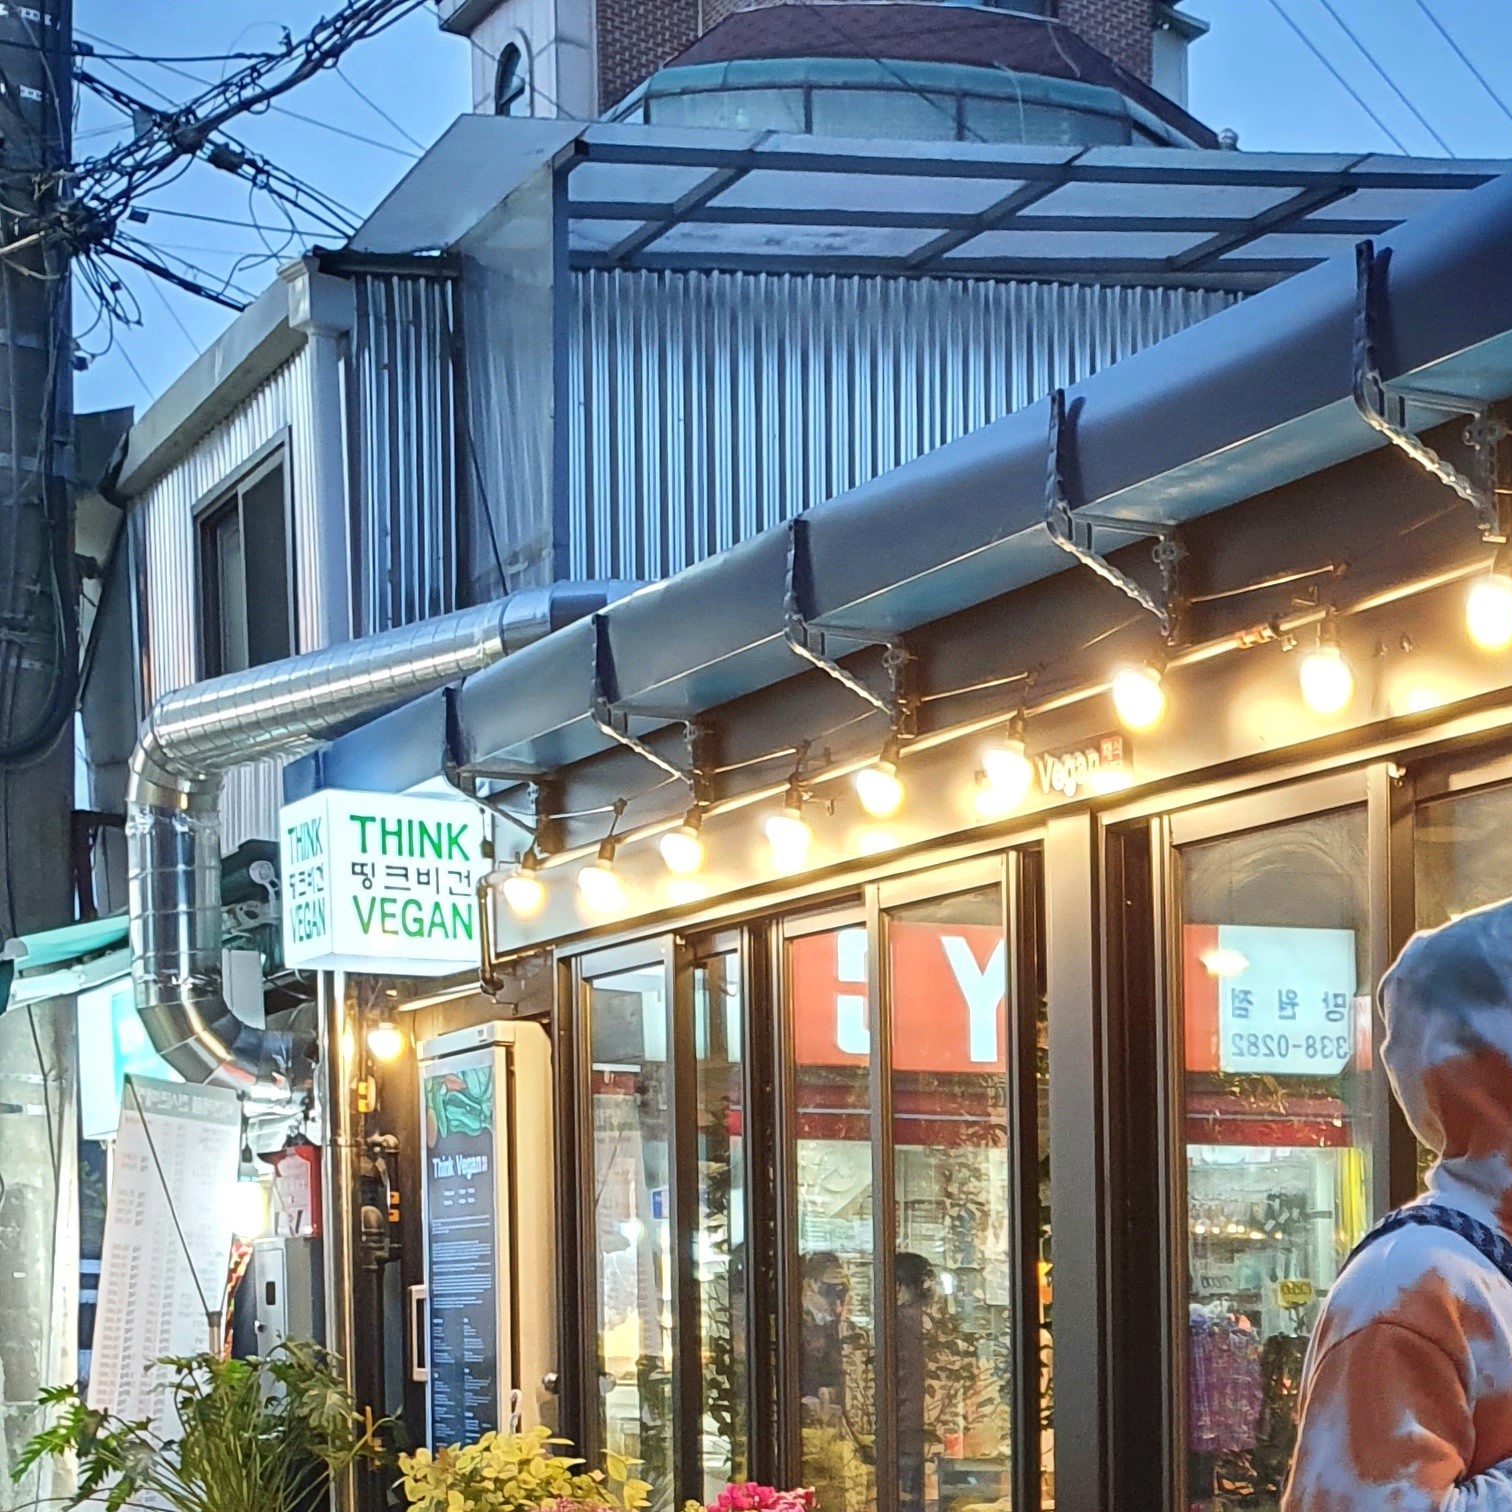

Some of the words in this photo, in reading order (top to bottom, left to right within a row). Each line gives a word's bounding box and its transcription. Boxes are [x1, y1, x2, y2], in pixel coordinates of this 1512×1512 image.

[287, 816, 324, 865] THINK
[350, 815, 470, 861] THINK
[351, 862, 472, 896] 띵크비건
[289, 896, 327, 944] VEGAN
[353, 895, 473, 940] VEGAN
[432, 1155, 455, 1179] Think
[456, 1154, 482, 1180] Vegan
